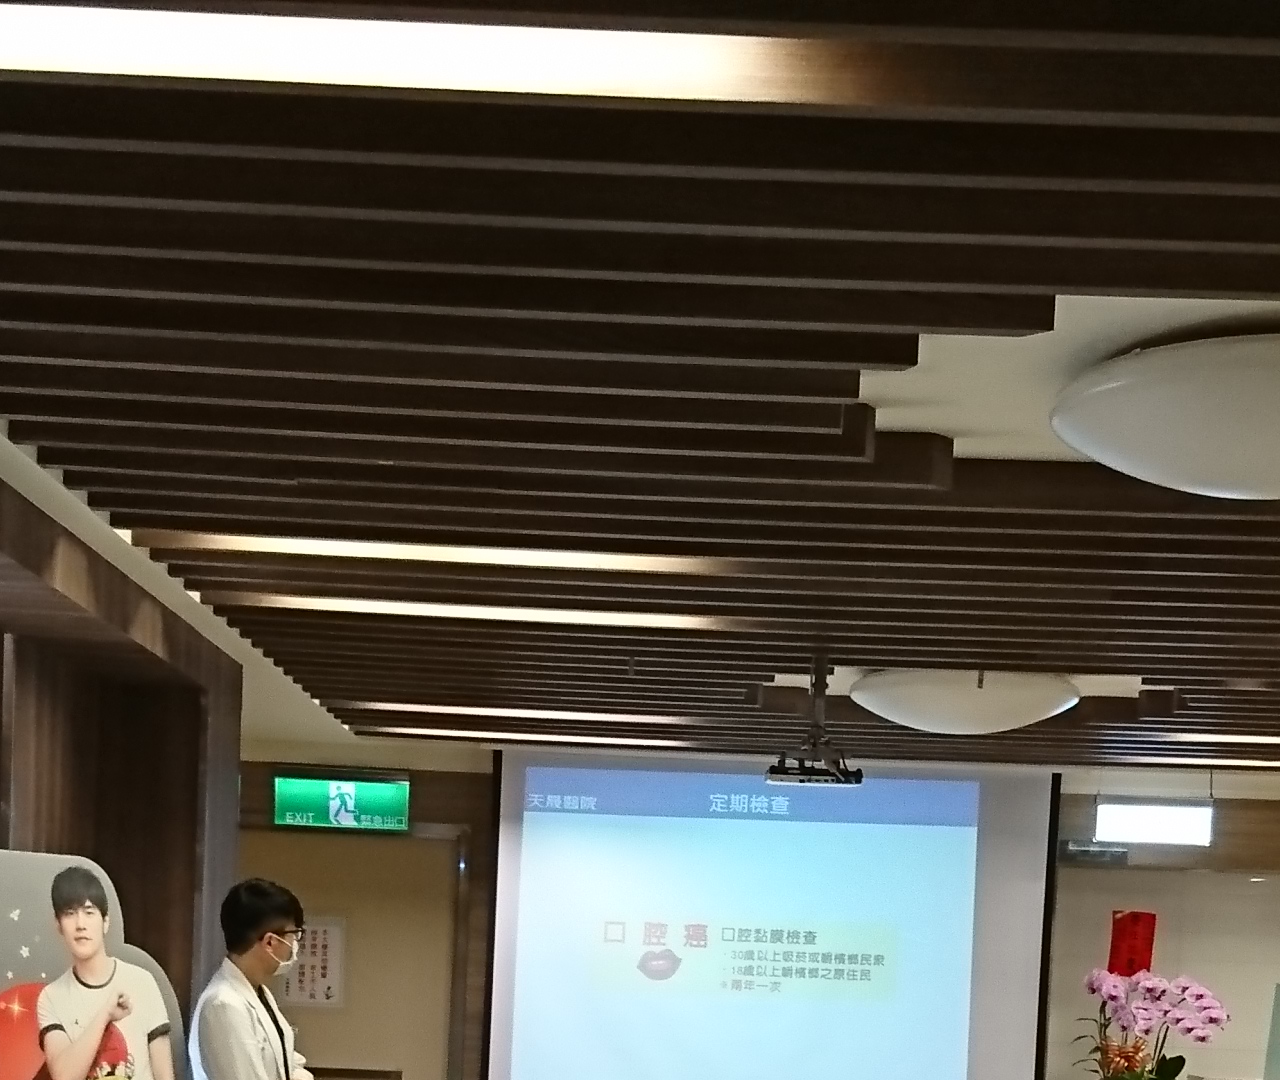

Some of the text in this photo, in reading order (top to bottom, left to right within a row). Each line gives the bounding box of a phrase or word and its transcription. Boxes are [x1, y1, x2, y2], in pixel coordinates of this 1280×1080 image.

[709, 793, 790, 815] 定期檢查
[285, 811, 406, 828] EXIT 緊急出口
[604, 921, 710, 948] 口腔癌
[721, 927, 817, 945] 口腔黏膜檢查
